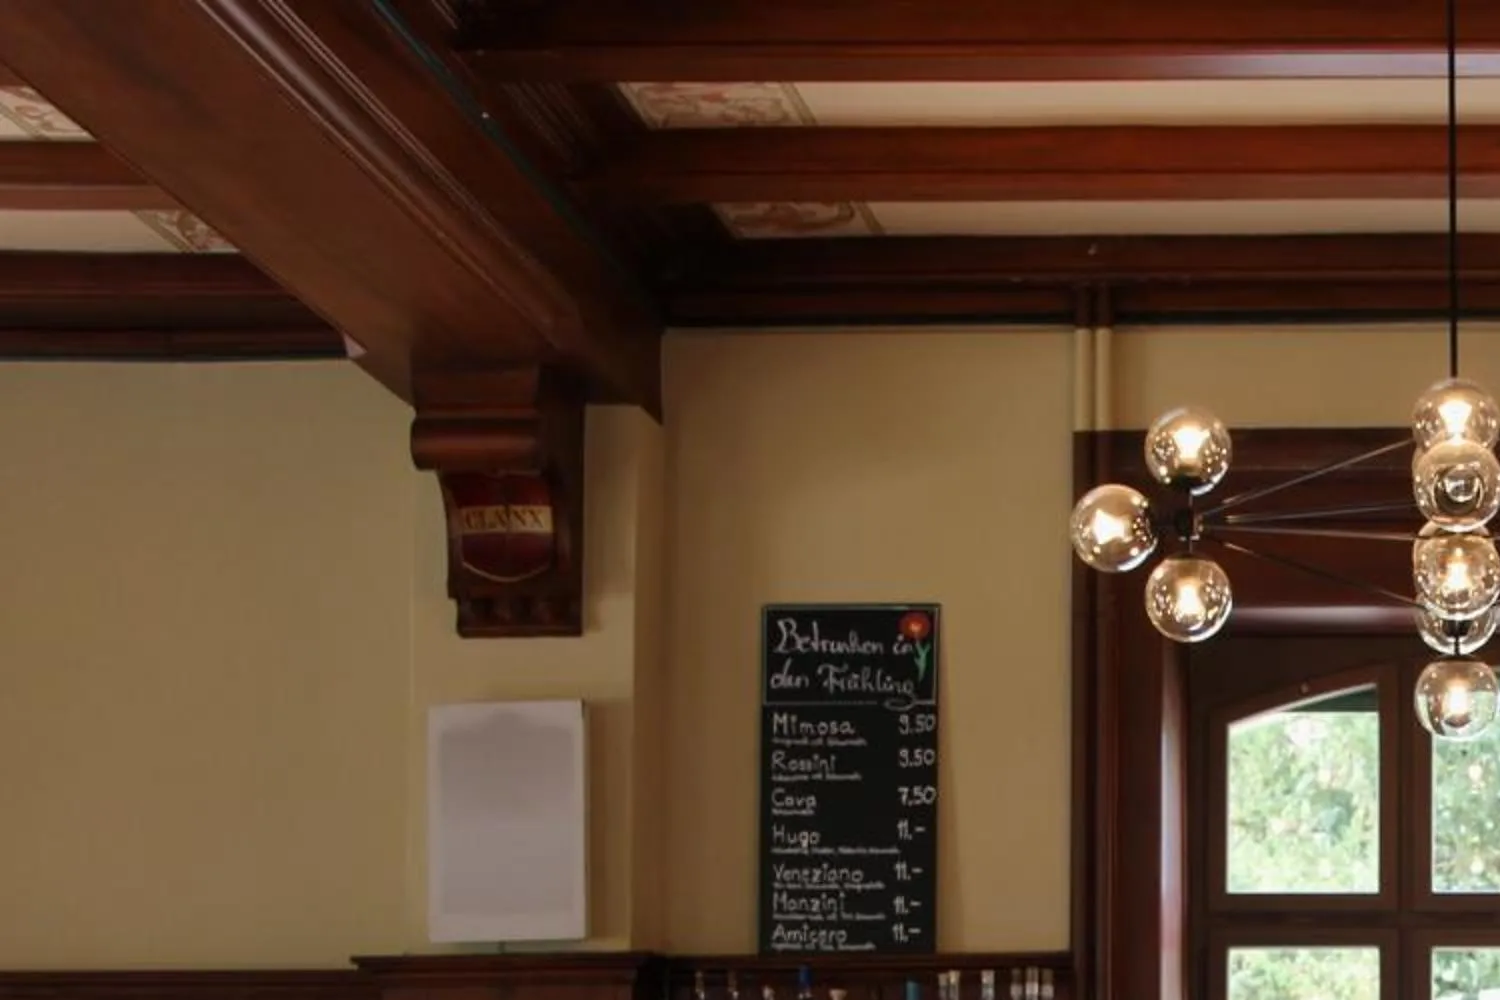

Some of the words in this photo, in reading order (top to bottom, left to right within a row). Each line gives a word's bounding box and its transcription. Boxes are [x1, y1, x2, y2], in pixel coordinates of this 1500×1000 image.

[772, 617, 884, 655] Betrunken
[770, 657, 809, 689] den
[817, 663, 917, 706] Frühling
[771, 711, 856, 737] Mimosa
[771, 750, 836, 771] Rossini
[771, 787, 817, 808] Cava
[771, 823, 821, 848] Hugo
[771, 862, 864, 883] Veneziano
